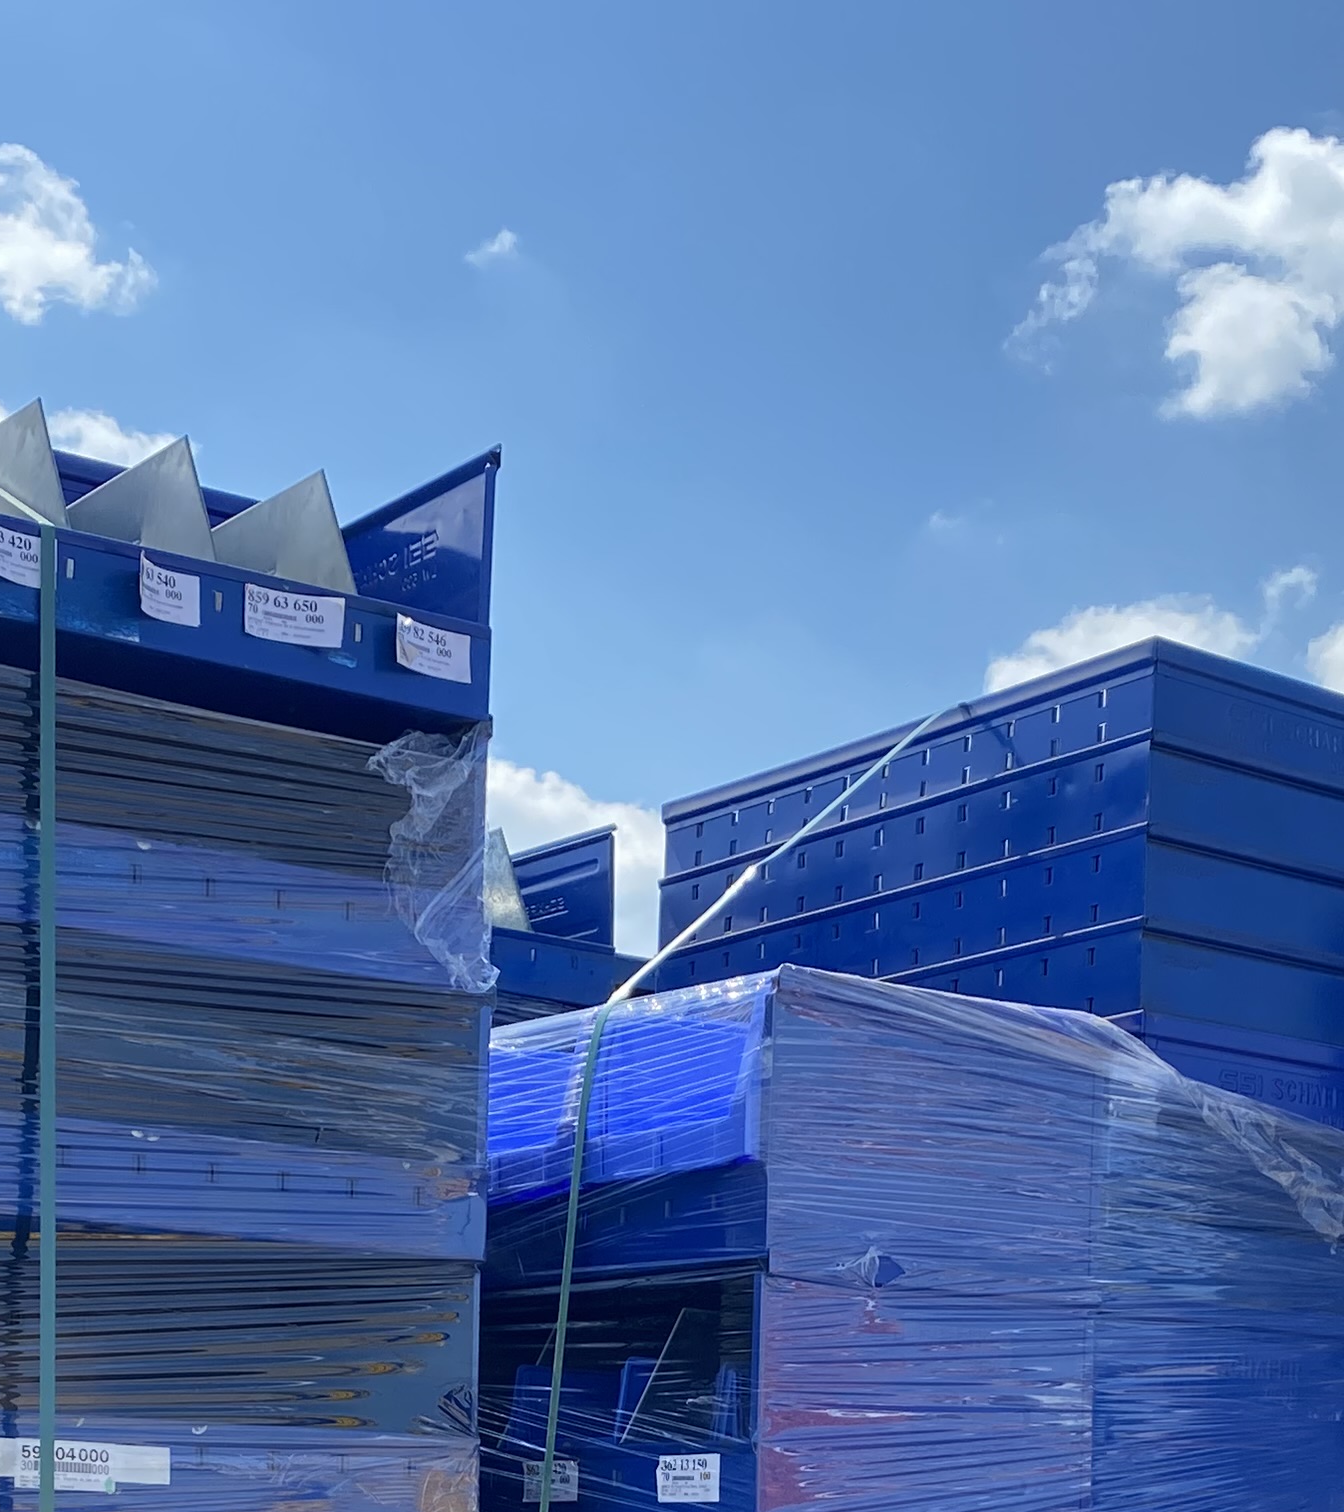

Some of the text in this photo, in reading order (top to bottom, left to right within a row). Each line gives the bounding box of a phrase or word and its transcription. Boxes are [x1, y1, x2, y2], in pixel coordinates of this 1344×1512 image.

[8, 533, 32, 551] 420
[20, 551, 38, 564] 000
[145, 566, 176, 589] 63 540
[165, 589, 182, 601] 000
[247, 589, 317, 613] 859 63 650
[248, 602, 324, 625] 70 000
[413, 627, 446, 647] 82 546
[436, 647, 452, 658] 000
[20, 1460, 109, 1475] 30 000
[680, 1458, 708, 1471] 13 150
[661, 1473, 670, 1482] 70
